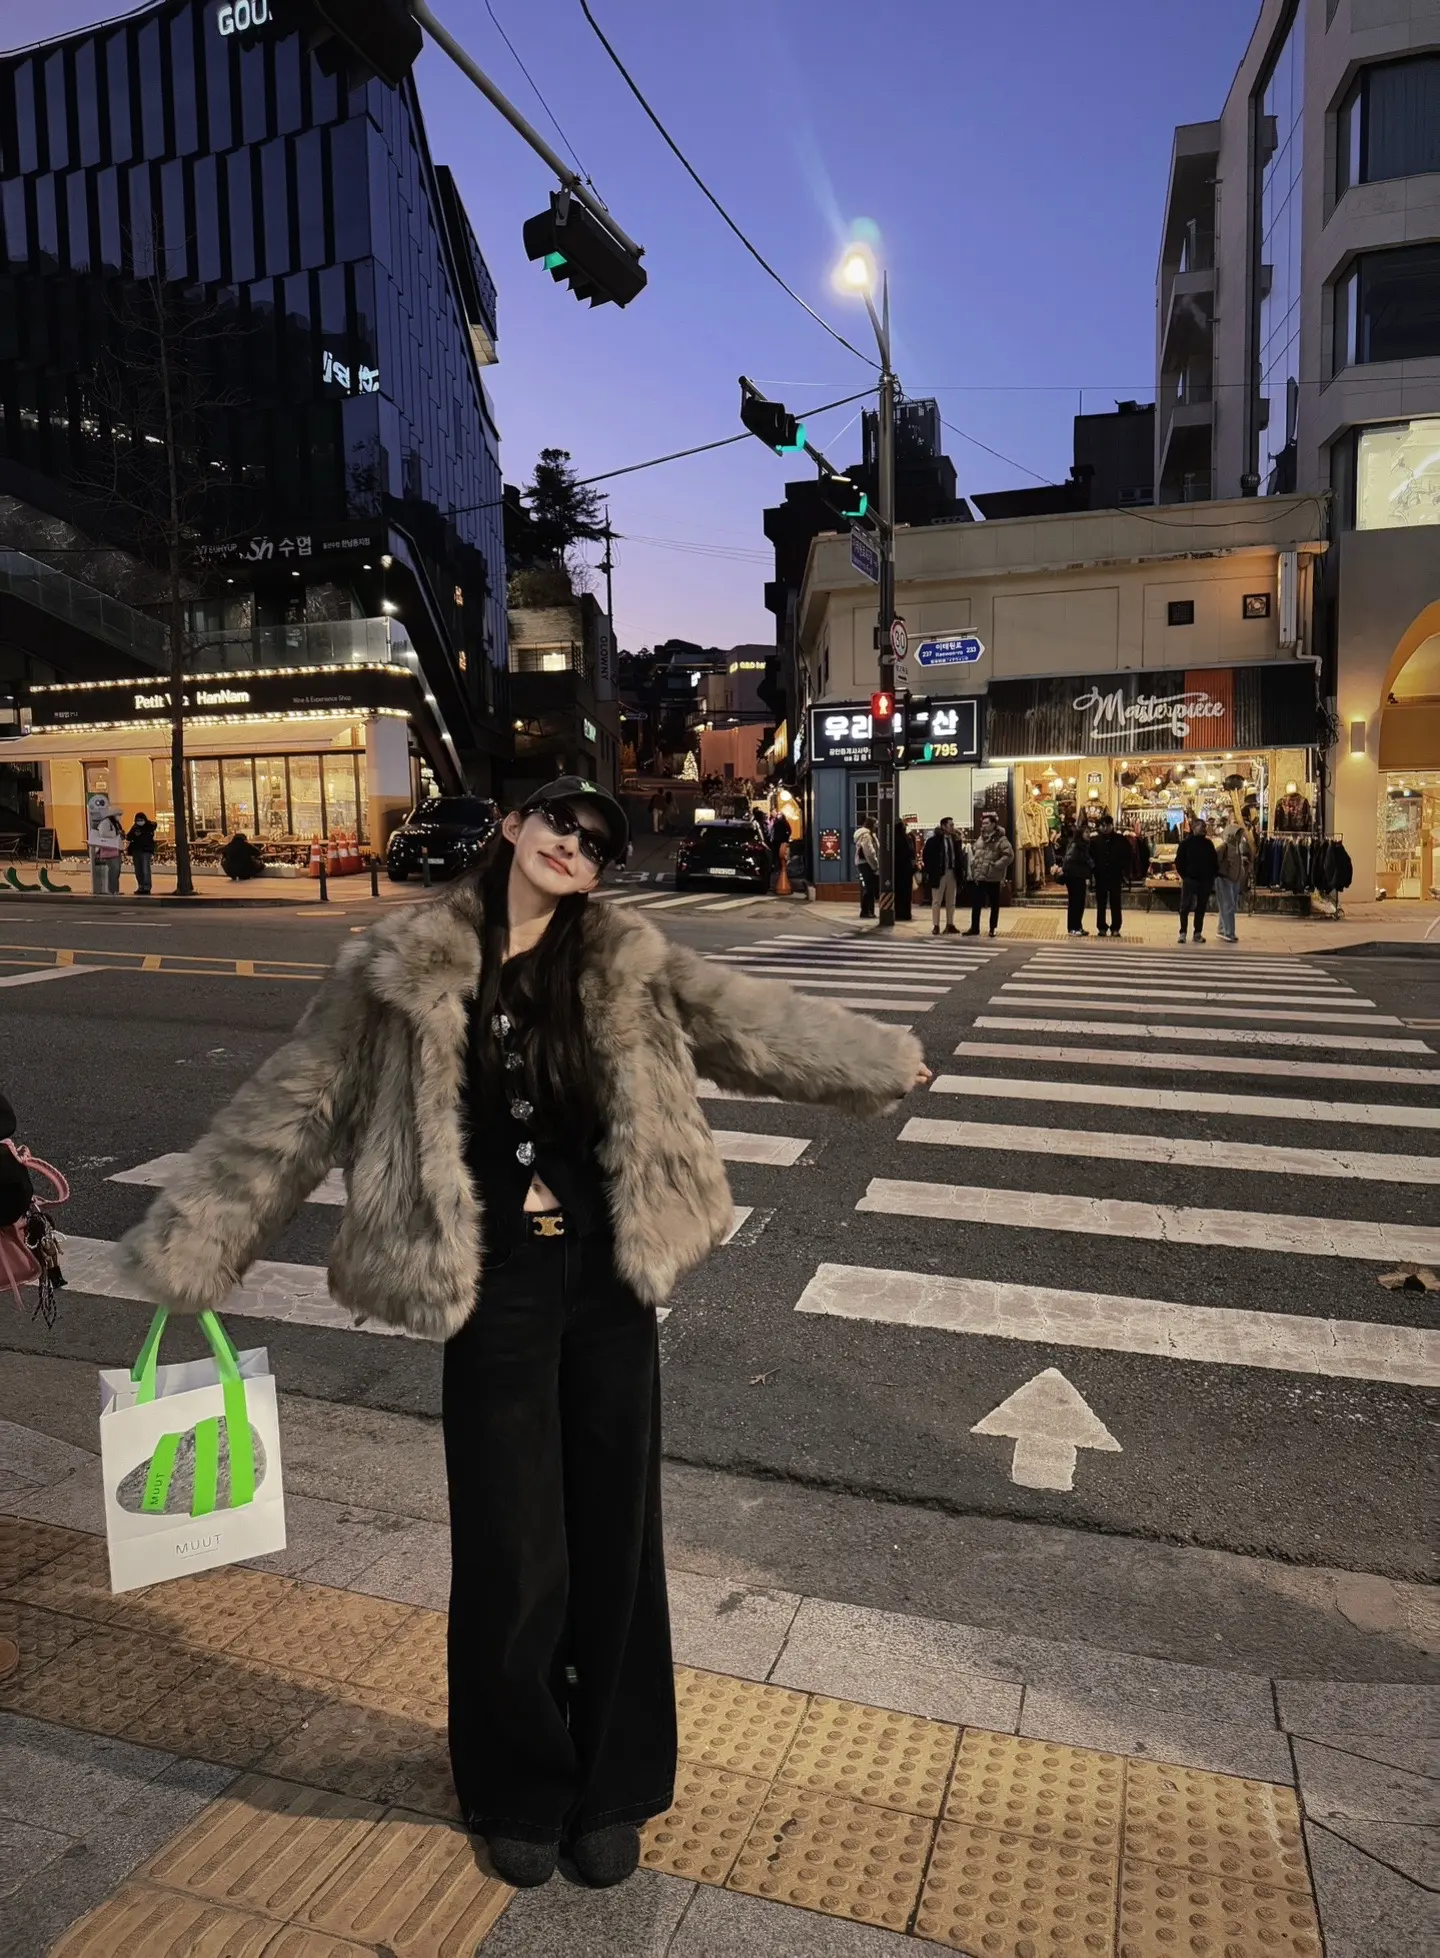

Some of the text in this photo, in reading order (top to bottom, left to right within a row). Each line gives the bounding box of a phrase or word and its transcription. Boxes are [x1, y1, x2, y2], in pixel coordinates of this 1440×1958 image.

[218, 0, 273, 36] GOU
[278, 535, 312, 558] 수협
[895, 630, 905, 649] 30
[935, 642, 963, 651] 이태원로
[134, 694, 165, 709] Petit
[196, 689, 250, 705] HanNam
[1073, 686, 1225, 739] Masterpiece
[150, 1473, 164, 1505] MUUT
[175, 1533, 221, 1554] MUUT
